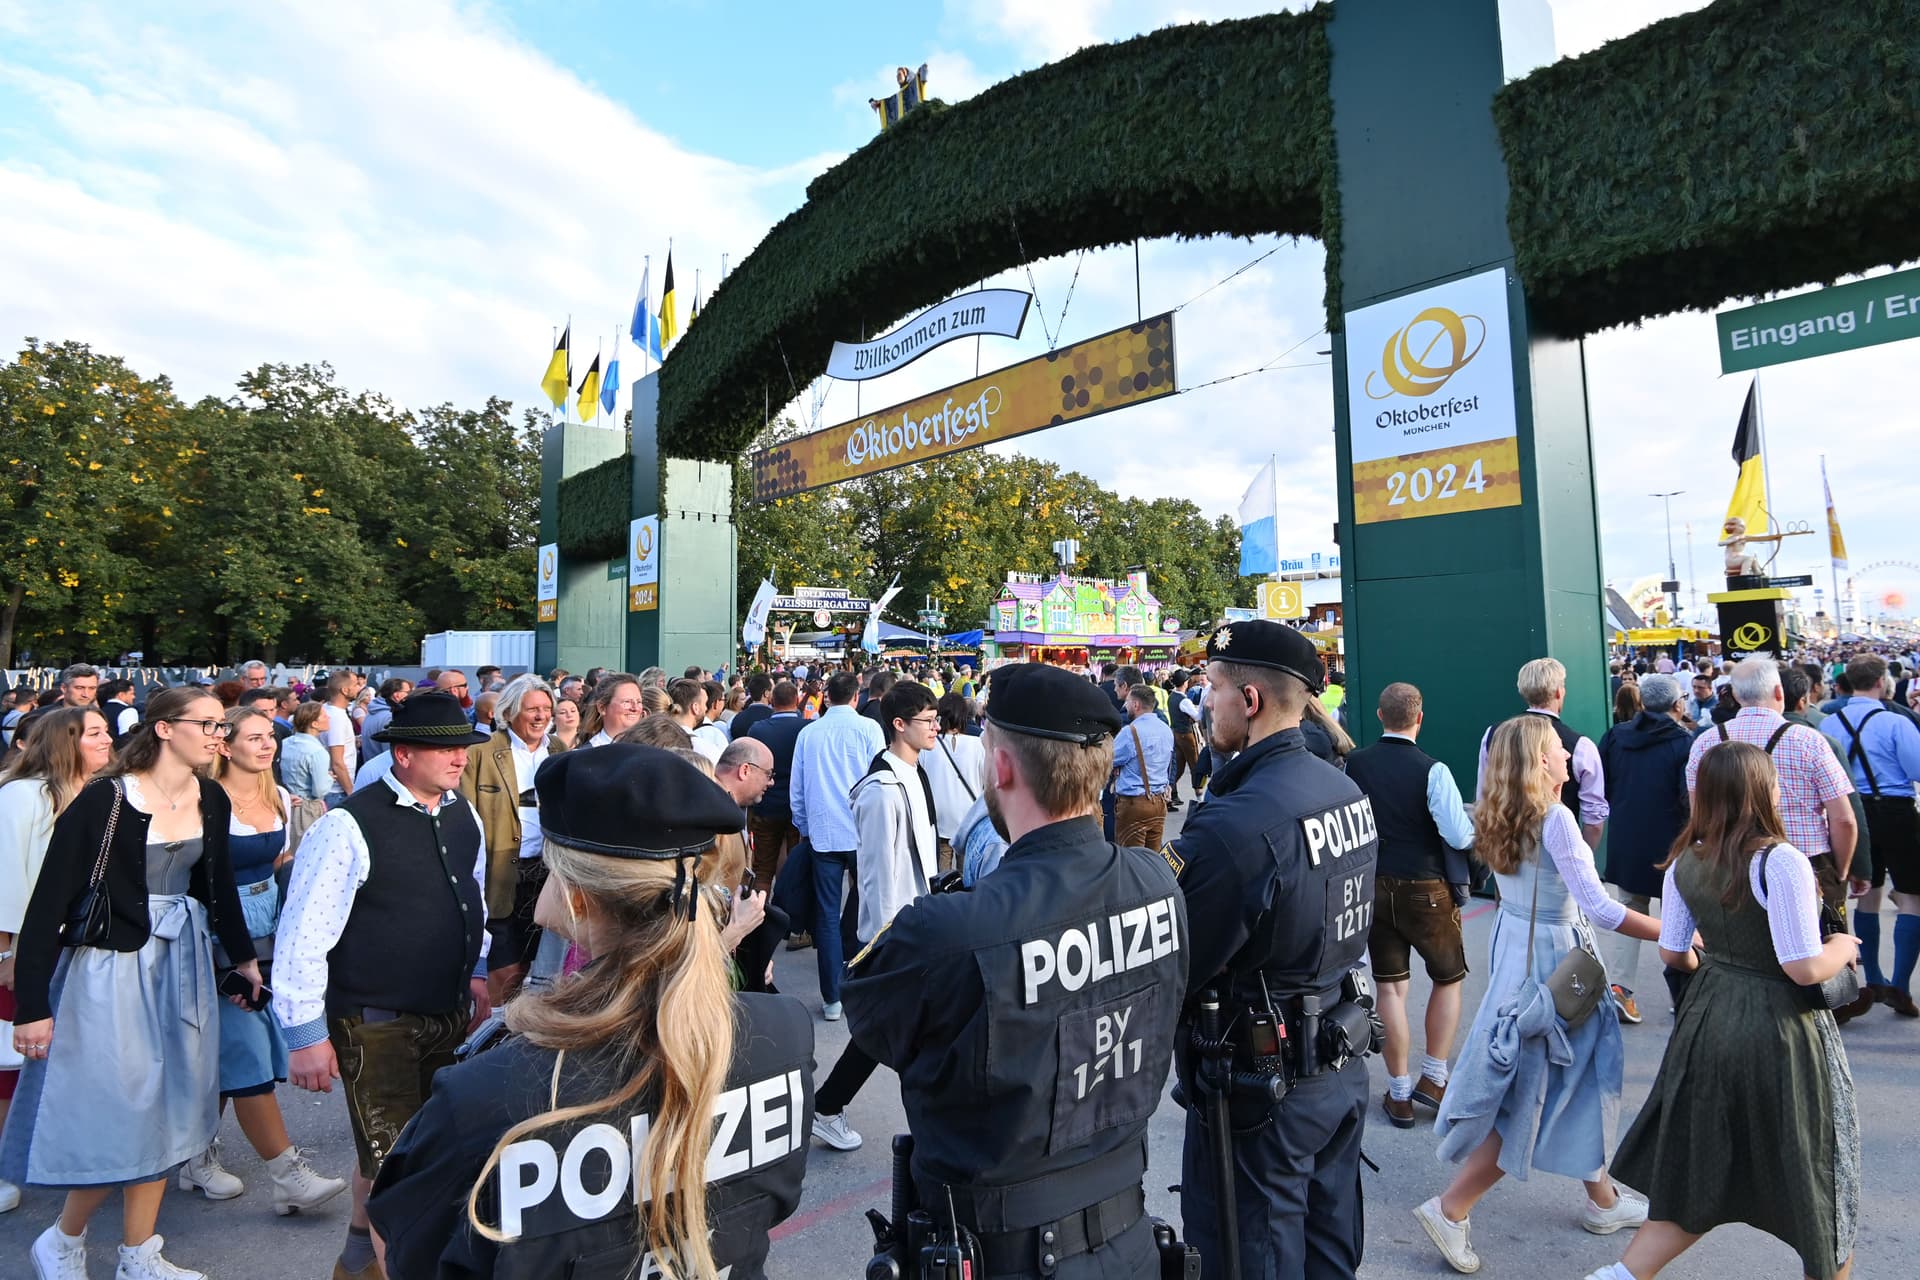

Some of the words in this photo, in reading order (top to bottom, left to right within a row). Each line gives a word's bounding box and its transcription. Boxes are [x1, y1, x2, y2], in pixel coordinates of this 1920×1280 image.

[854, 315, 946, 371] Willkommen
[952, 304, 986, 330] zum
[1731, 310, 1856, 351] Eingang
[1865, 300, 1874, 324] /
[844, 386, 1001, 467] Oktoberfest
[1376, 395, 1480, 429] Oktoberfest
[1403, 421, 1451, 437] MÜNCHEN
[1386, 458, 1488, 506] 2024
[1281, 560, 1303, 571] Bräu
[634, 590, 653, 606] 2024
[774, 598, 868, 610] WEISSBIERGARTEN
[797, 590, 847, 600] KOLLMANNS
[1304, 796, 1378, 866] POLIZEI
[1344, 873, 1364, 908] BY
[1335, 901, 1371, 942] 1211
[1021, 897, 1180, 1005] POLIZEI
[1096, 1006, 1132, 1055] BY
[500, 1069, 803, 1242] POLZEI
